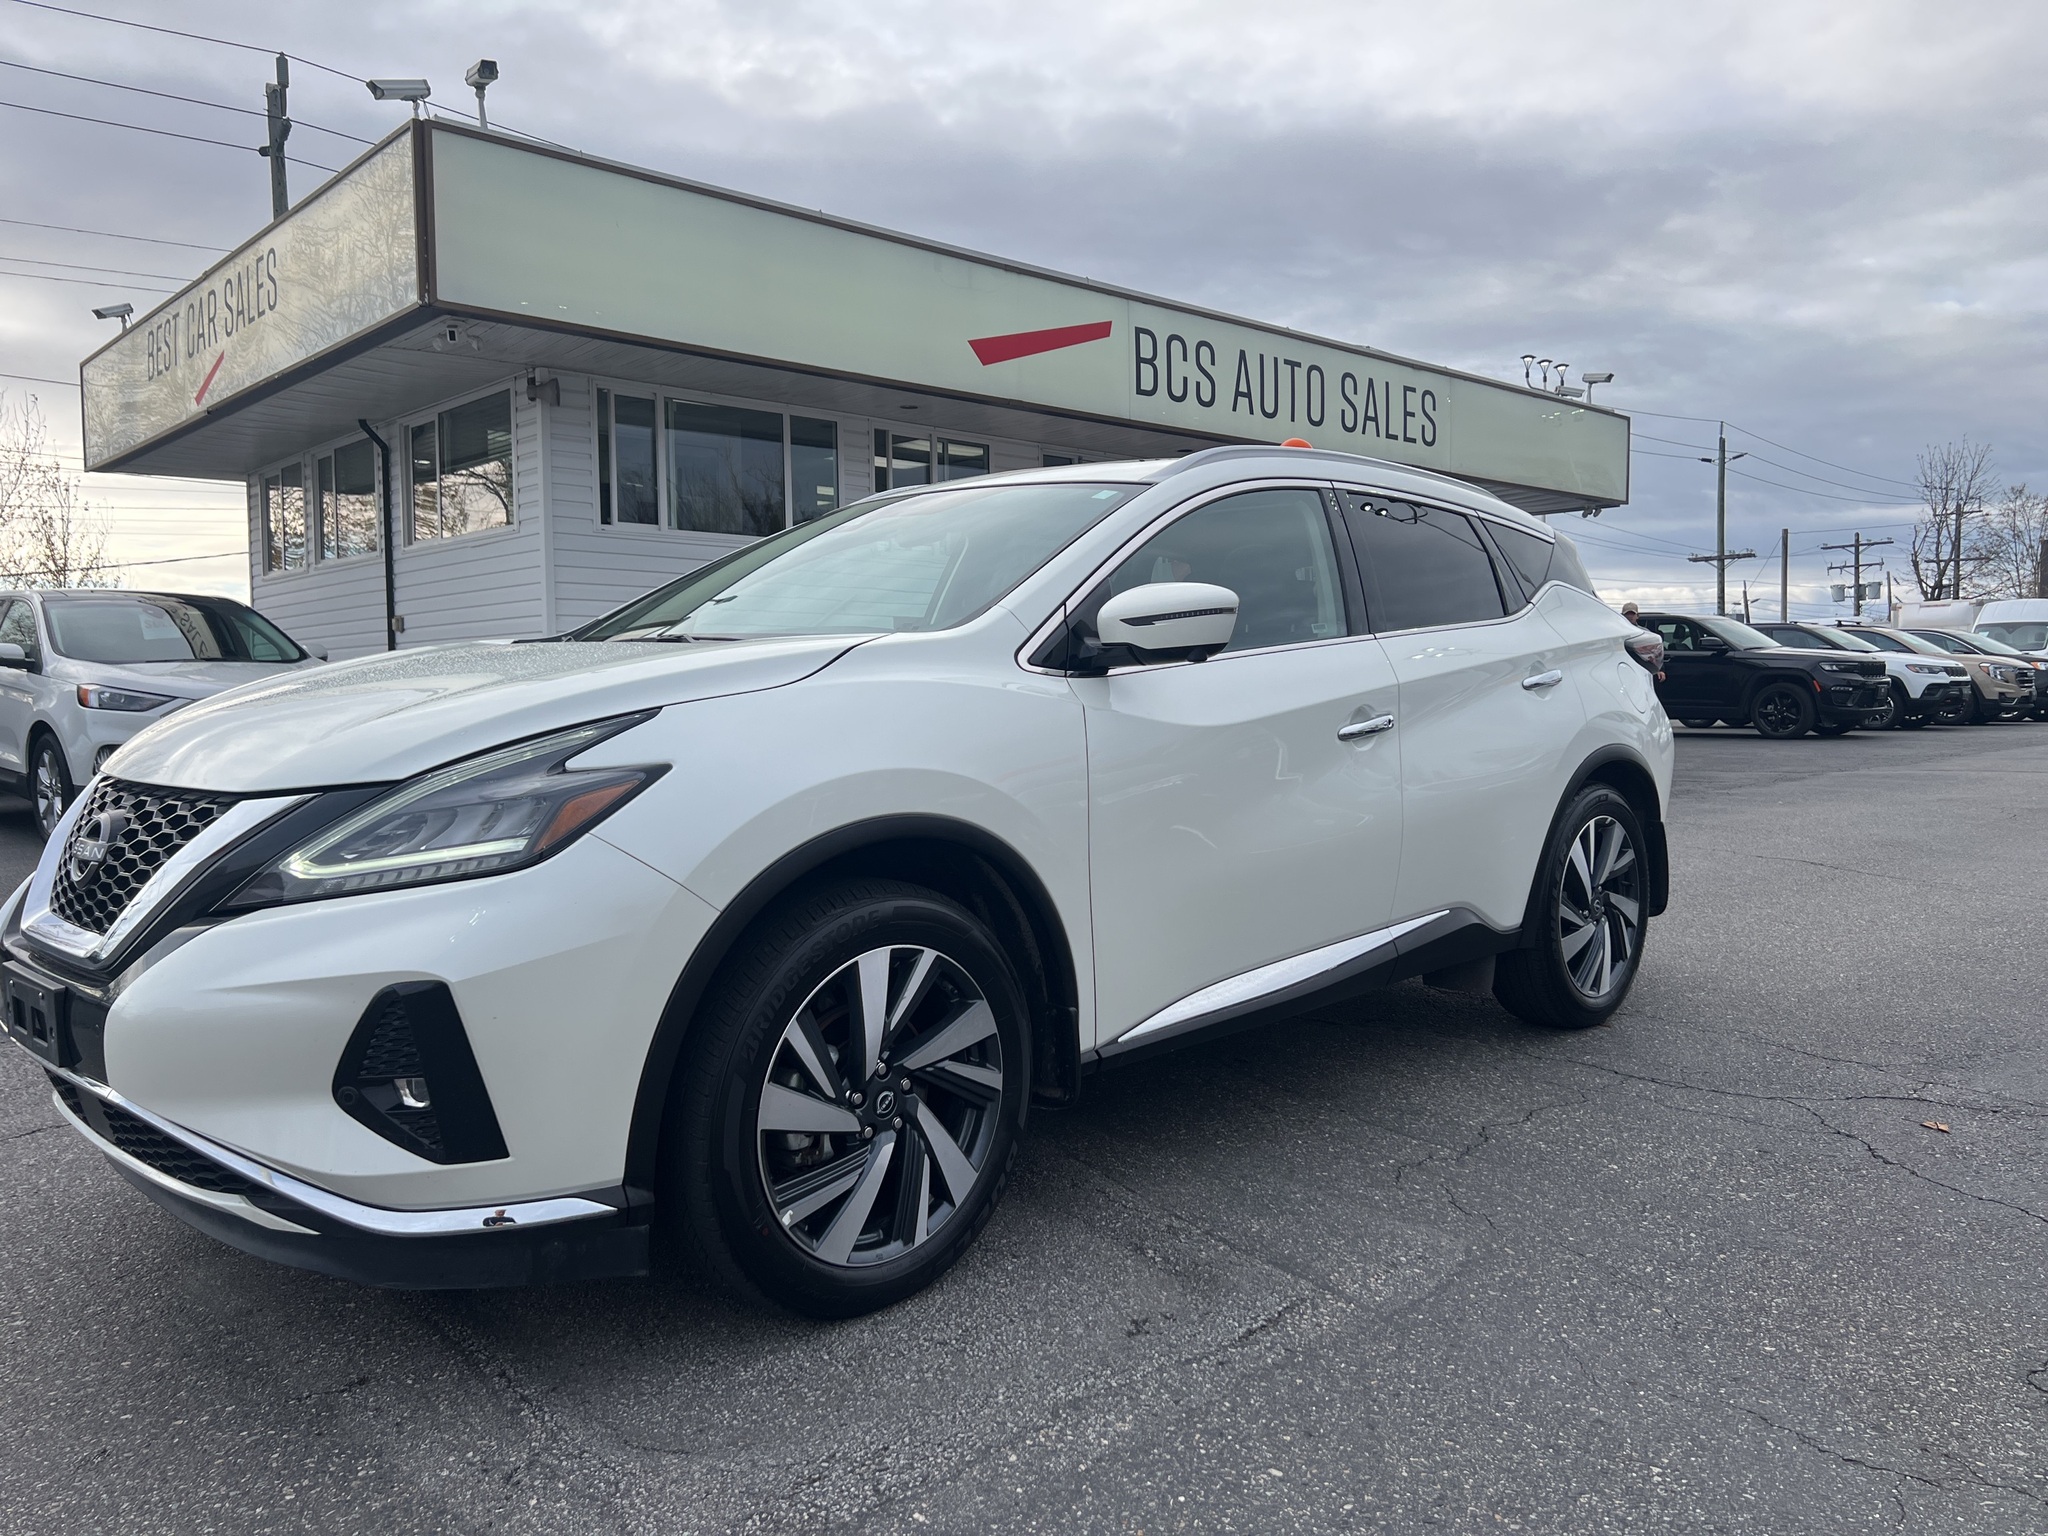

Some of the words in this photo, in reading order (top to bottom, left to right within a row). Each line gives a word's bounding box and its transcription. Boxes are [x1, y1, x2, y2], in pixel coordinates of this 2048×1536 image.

[147, 312, 180, 382] BEST
[187, 289, 218, 359] CAR
[224, 247, 278, 338] SALES
[1134, 326, 1216, 408] BCS
[1231, 349, 1325, 427] AUTO
[1340, 372, 1437, 447] SALES
